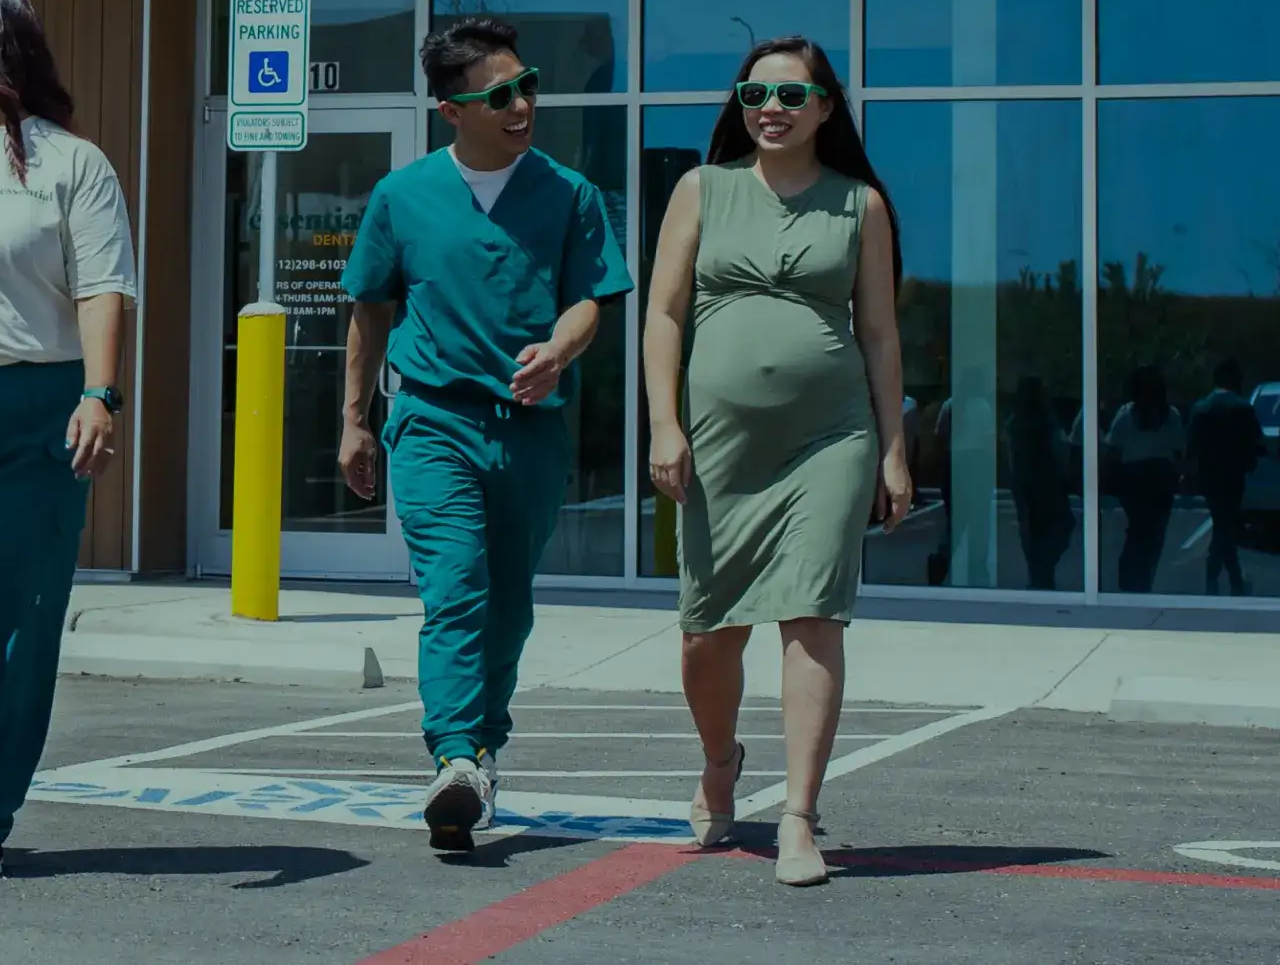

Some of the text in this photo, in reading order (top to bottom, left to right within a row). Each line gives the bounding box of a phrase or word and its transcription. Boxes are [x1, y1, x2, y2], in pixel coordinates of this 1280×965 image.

[239, 24, 300, 40] PARKING
[236, 117, 299, 127] VIOLATORS SUBJECT
[235, 131, 300, 141] TO FINE AND TOWING
[313, 234, 356, 246] DENT
[291, 281, 304, 290] OF
[305, 281, 344, 290] OPERAT
[293, 307, 336, 315] 8AM-1PM
